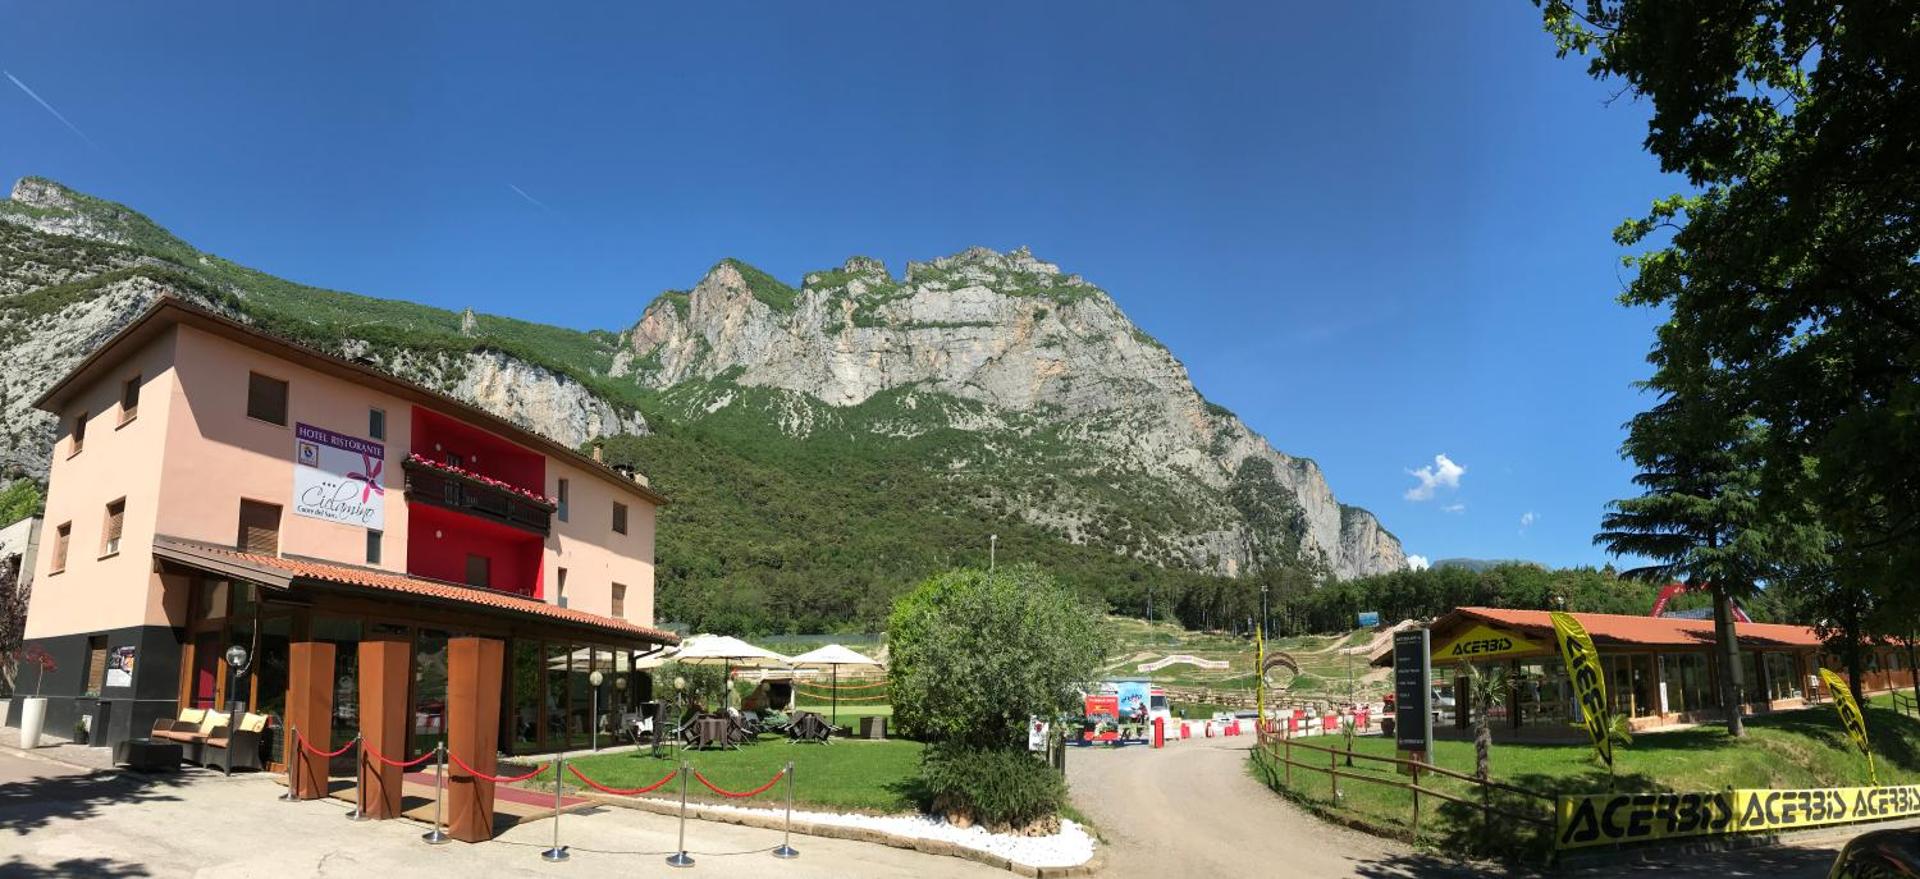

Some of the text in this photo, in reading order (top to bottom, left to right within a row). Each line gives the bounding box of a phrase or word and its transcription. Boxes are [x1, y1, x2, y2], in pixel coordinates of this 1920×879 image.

[299, 426, 382, 455] HOTEL RISTORANTE
[1452, 638, 1513, 655] ACERBIS
[1561, 792, 1732, 843] ACERBIS
[1741, 791, 1847, 826] ACERBIS
